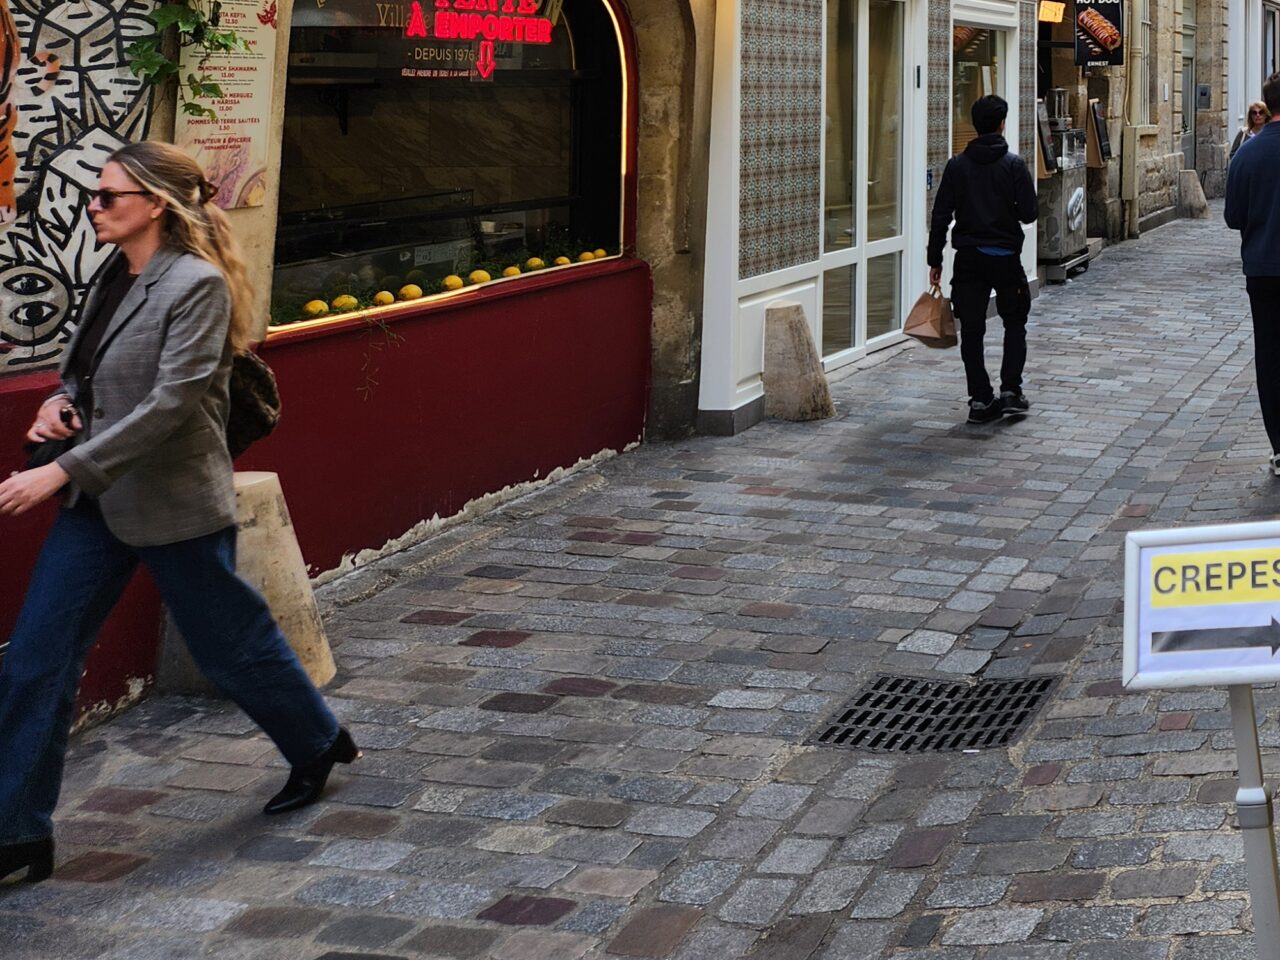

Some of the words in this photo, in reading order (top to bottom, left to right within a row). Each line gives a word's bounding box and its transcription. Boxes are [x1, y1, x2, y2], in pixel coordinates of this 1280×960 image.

[406, 0, 427, 38] À
[434, 11, 553, 43] EMPORTER
[415, 48, 451, 60] DEPUIS
[454, 48, 475, 61] 1976
